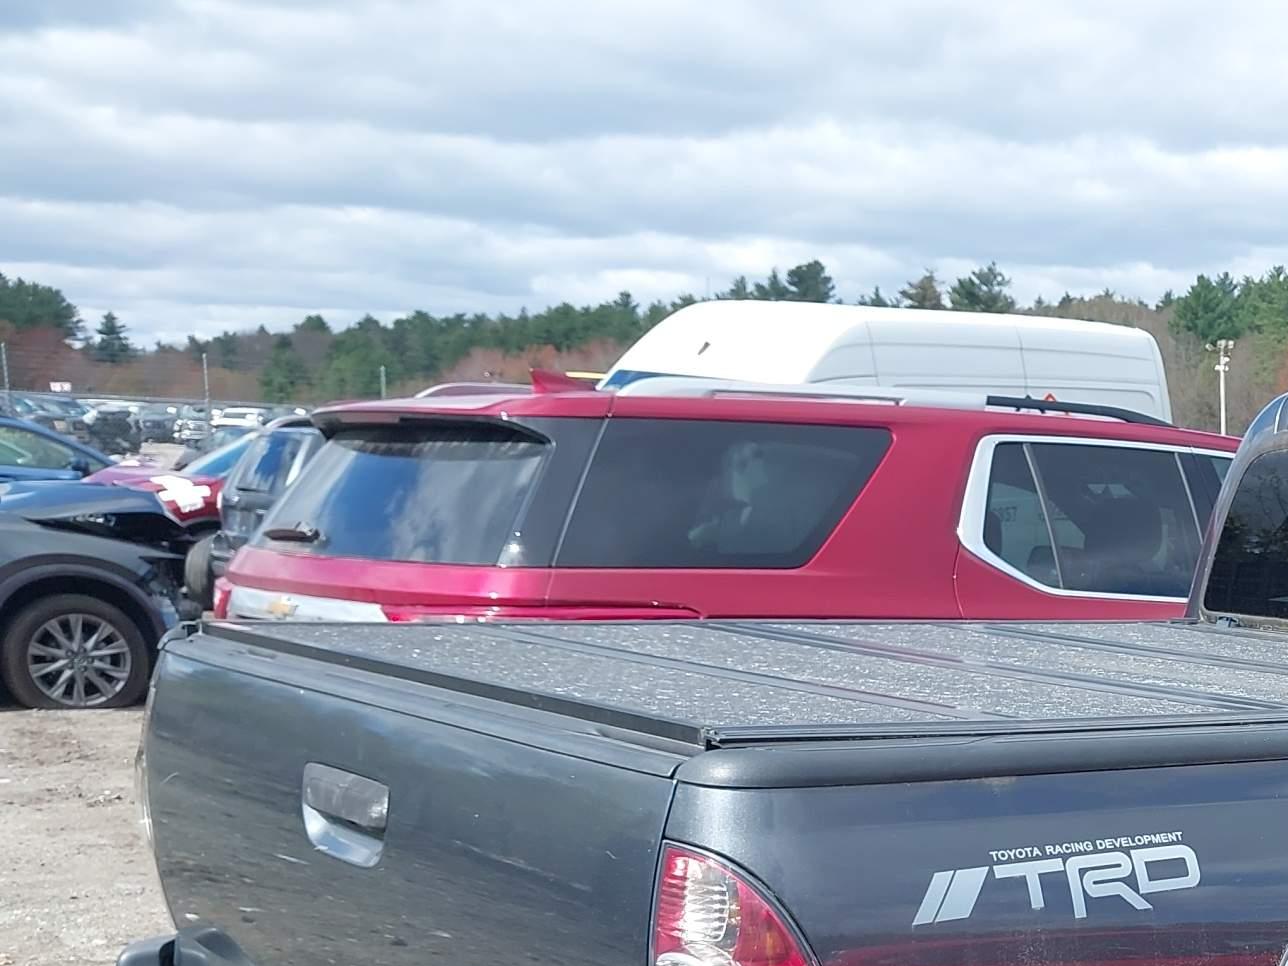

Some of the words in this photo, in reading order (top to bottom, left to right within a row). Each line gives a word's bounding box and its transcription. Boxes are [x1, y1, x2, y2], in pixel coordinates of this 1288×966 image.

[989, 847, 1043, 862] TOYOTA
[1046, 840, 1094, 856] RACING
[1096, 831, 1184, 850] DEVELOPMENT
[993, 844, 1201, 919] TRD
